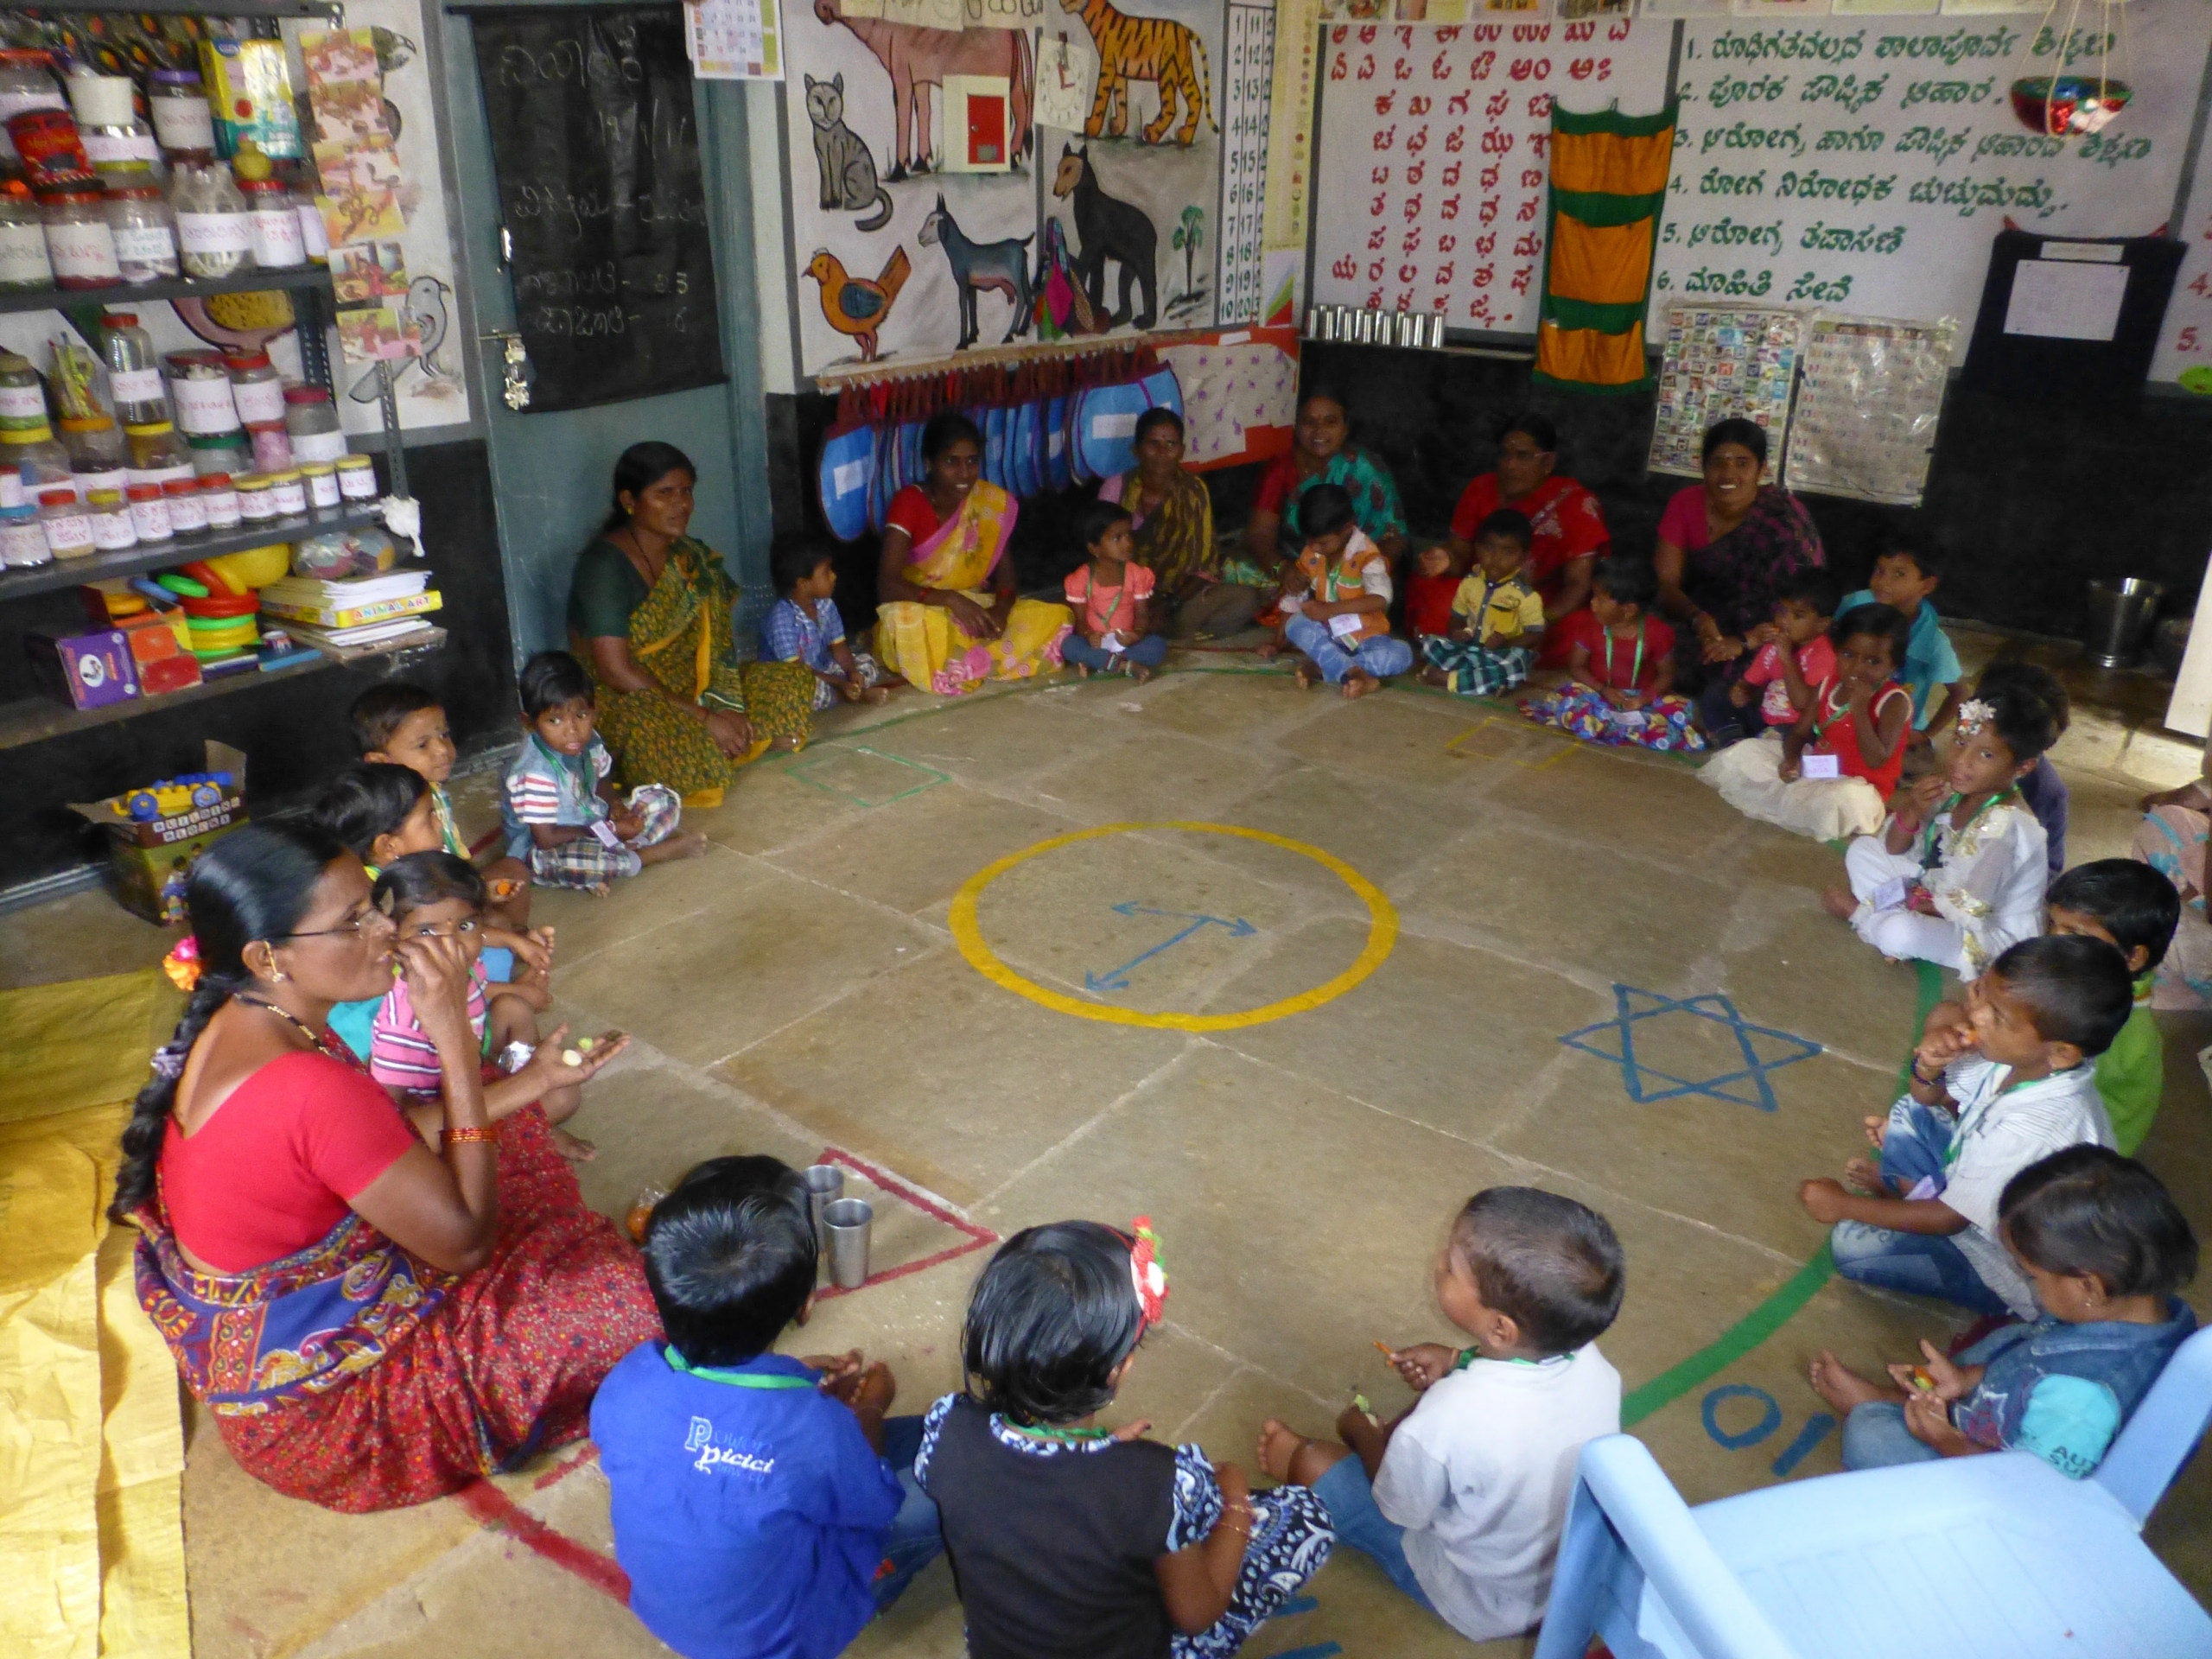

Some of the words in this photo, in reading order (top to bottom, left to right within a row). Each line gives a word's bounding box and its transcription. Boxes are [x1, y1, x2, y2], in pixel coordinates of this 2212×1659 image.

[1236, 14, 1241, 34] 1
[1250, 15, 1261, 34] 11
[1473, 23, 1503, 43] ಉ
[1234, 44, 1242, 65] 2
[1249, 44, 1260, 65] 12
[1688, 38, 1703, 60] 1.
[1233, 79, 1241, 101] 3
[1246, 78, 1259, 102] 13
[1231, 116, 1241, 137] 4
[1244, 114, 1257, 137] 14
[1231, 151, 1239, 173] 5
[1242, 149, 1256, 173] 15
[1230, 184, 1237, 204] 6
[1242, 183, 1254, 204] 16
[1227, 216, 1236, 238] 7
[1240, 214, 1253, 235] 17
[1226, 245, 1235, 267] 8
[1239, 241, 1252, 262] 18
[1225, 273, 1234, 294] 9
[1238, 270, 1251, 292] 19
[1221, 300, 1233, 321] 10
[1237, 296, 1250, 318] 20
[353, 602, 404, 621] ANIMAL
[407, 594, 432, 610] ART
